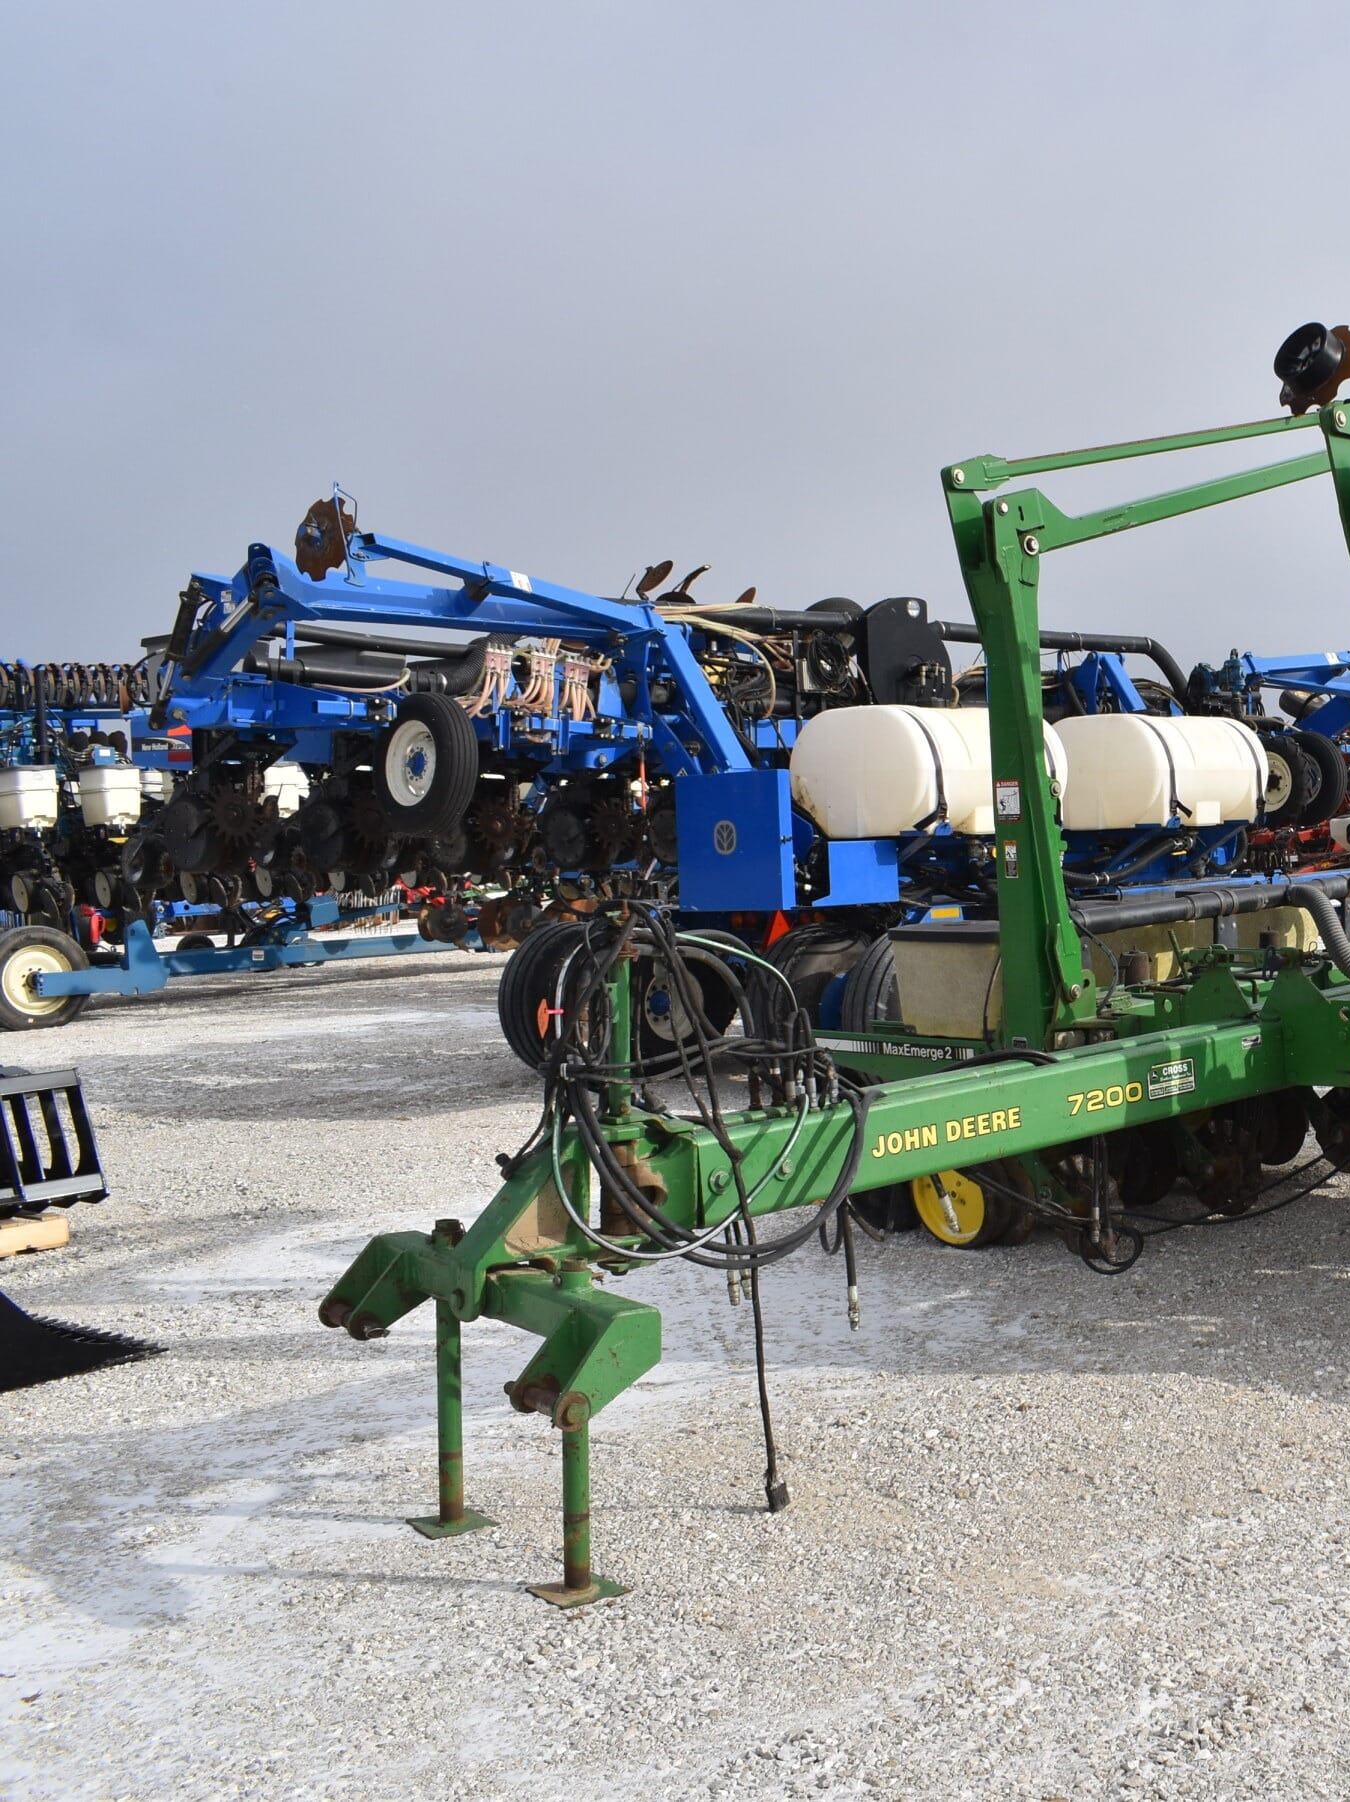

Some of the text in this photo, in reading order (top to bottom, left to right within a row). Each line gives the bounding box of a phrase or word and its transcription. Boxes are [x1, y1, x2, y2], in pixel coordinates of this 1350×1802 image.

[882, 1042, 952, 1061] MaxEmerge 2
[1162, 1063, 1188, 1076] CROSS
[1067, 1081, 1143, 1116] 7200
[871, 1106, 1022, 1158] JOHN DEERE
